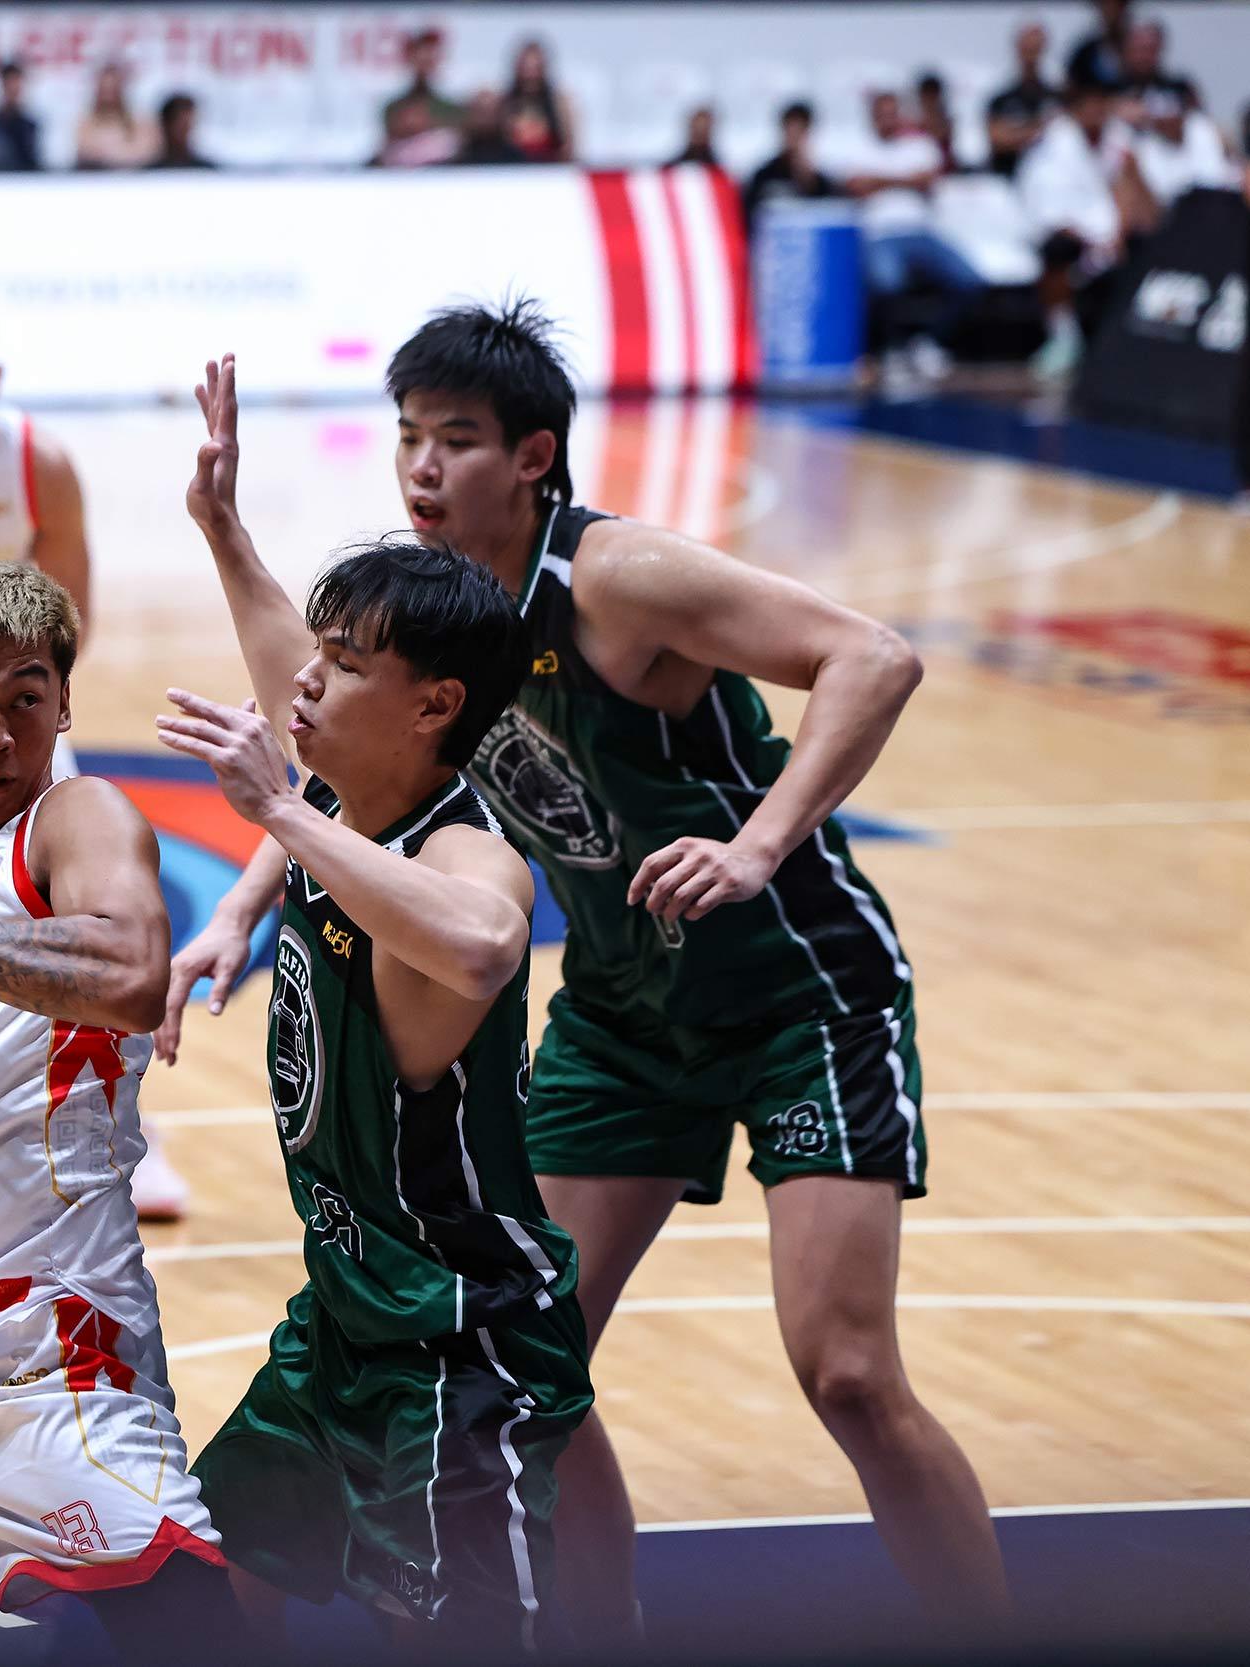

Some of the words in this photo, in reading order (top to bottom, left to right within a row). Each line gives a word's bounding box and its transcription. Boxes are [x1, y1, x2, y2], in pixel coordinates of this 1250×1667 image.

[8, 18, 312, 72] SECTION
[766, 1100, 829, 1157] 18
[40, 1500, 111, 1556] 13
